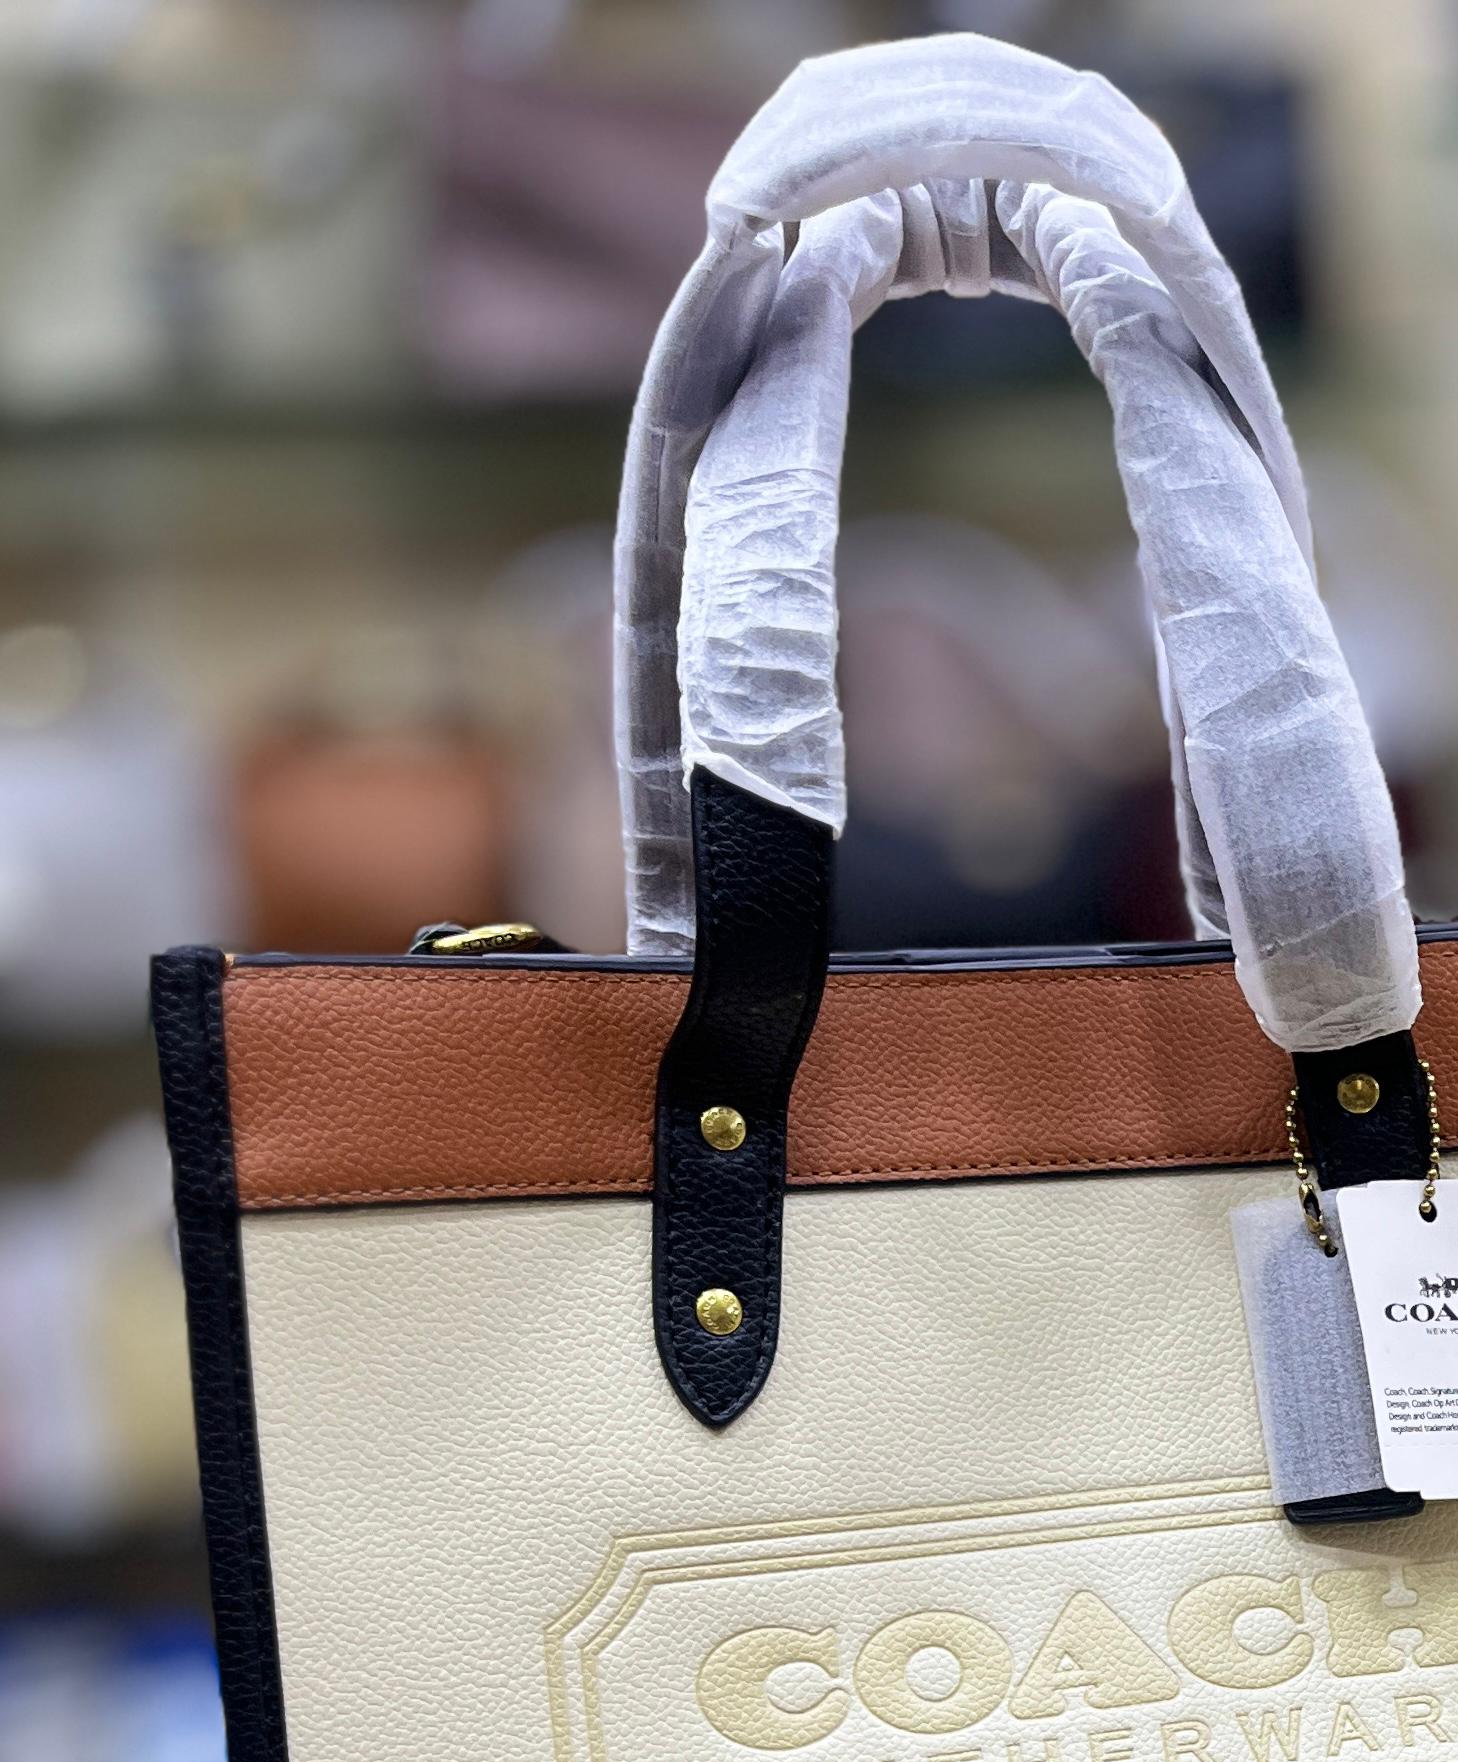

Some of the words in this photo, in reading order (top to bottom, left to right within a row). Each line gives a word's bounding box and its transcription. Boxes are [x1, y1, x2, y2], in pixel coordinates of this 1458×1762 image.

[1412, 1399, 1432, 1407] Coach
[1389, 1412, 1411, 1422] Design
[1426, 1411, 1447, 1419] Coach
